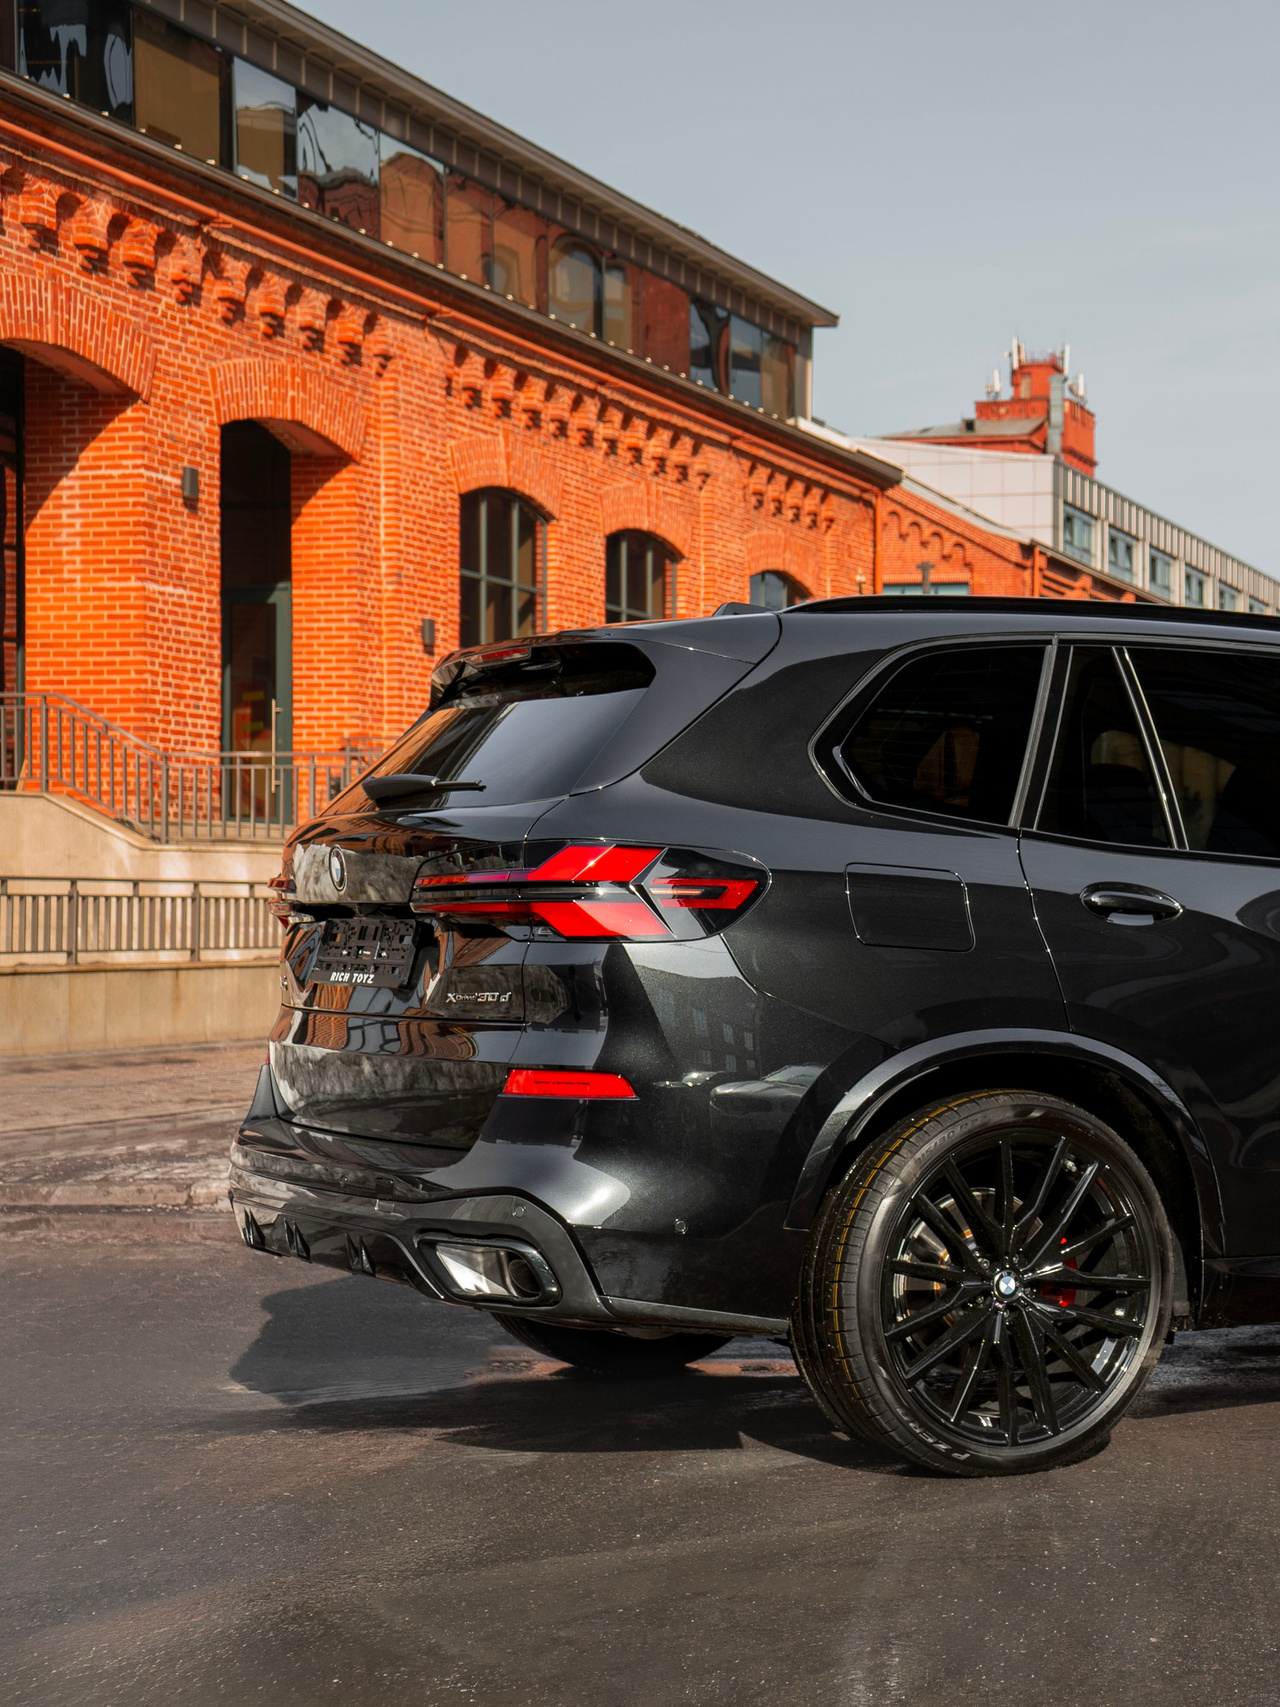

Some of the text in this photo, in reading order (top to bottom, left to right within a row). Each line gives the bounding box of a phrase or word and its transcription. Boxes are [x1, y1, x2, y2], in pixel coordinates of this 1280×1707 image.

[329, 971, 375, 984] RICH TOYZ
[951, 1452, 971, 1461] P
